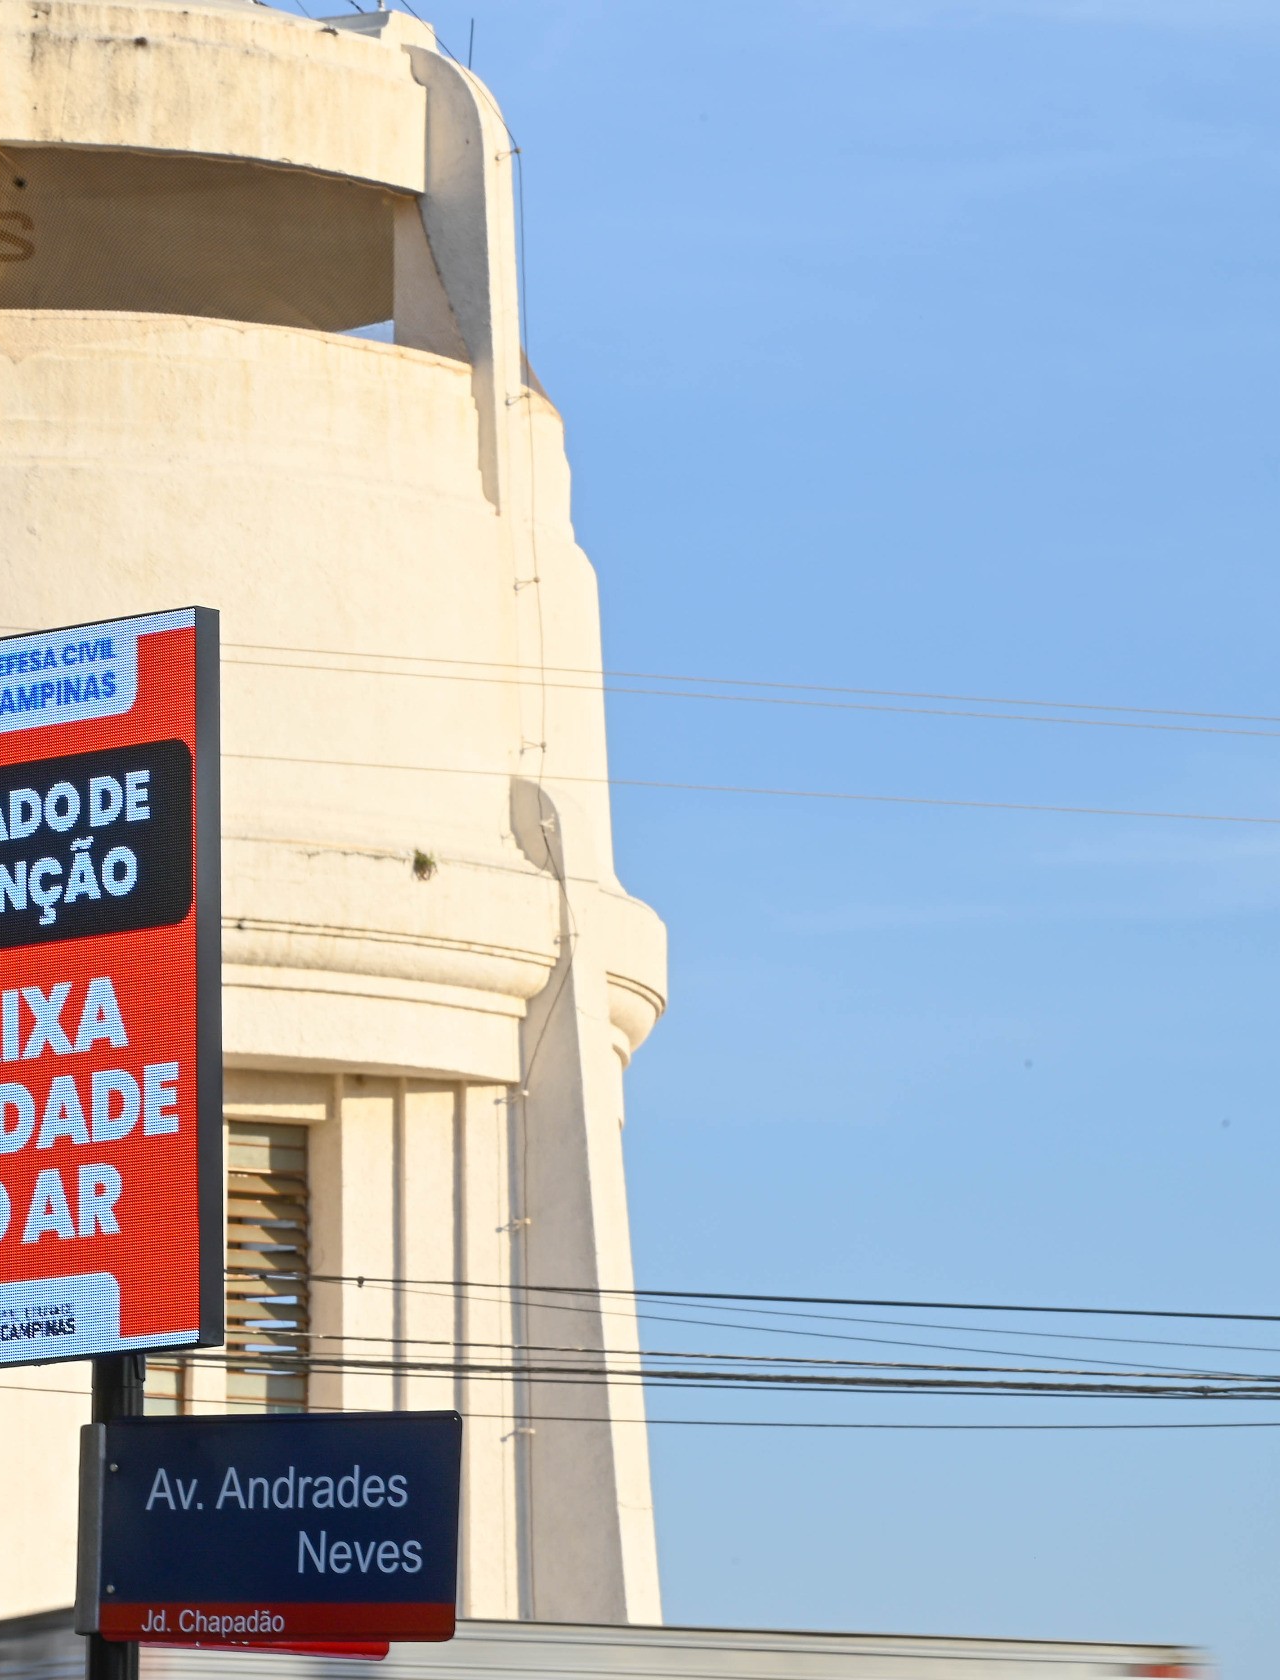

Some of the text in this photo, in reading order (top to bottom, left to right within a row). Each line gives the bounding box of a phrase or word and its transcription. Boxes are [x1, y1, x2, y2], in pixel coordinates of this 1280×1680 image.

[61, 636, 117, 667] CIVIL
[88, 769, 151, 828] DE
[20, 1162, 123, 1245] AR
[0, 1317, 75, 1341] CAMPINAS
[145, 1464, 408, 1511] Av. Andrades
[297, 1529, 423, 1575] Neves
[141, 1609, 285, 1638] Jd. Chapadão
